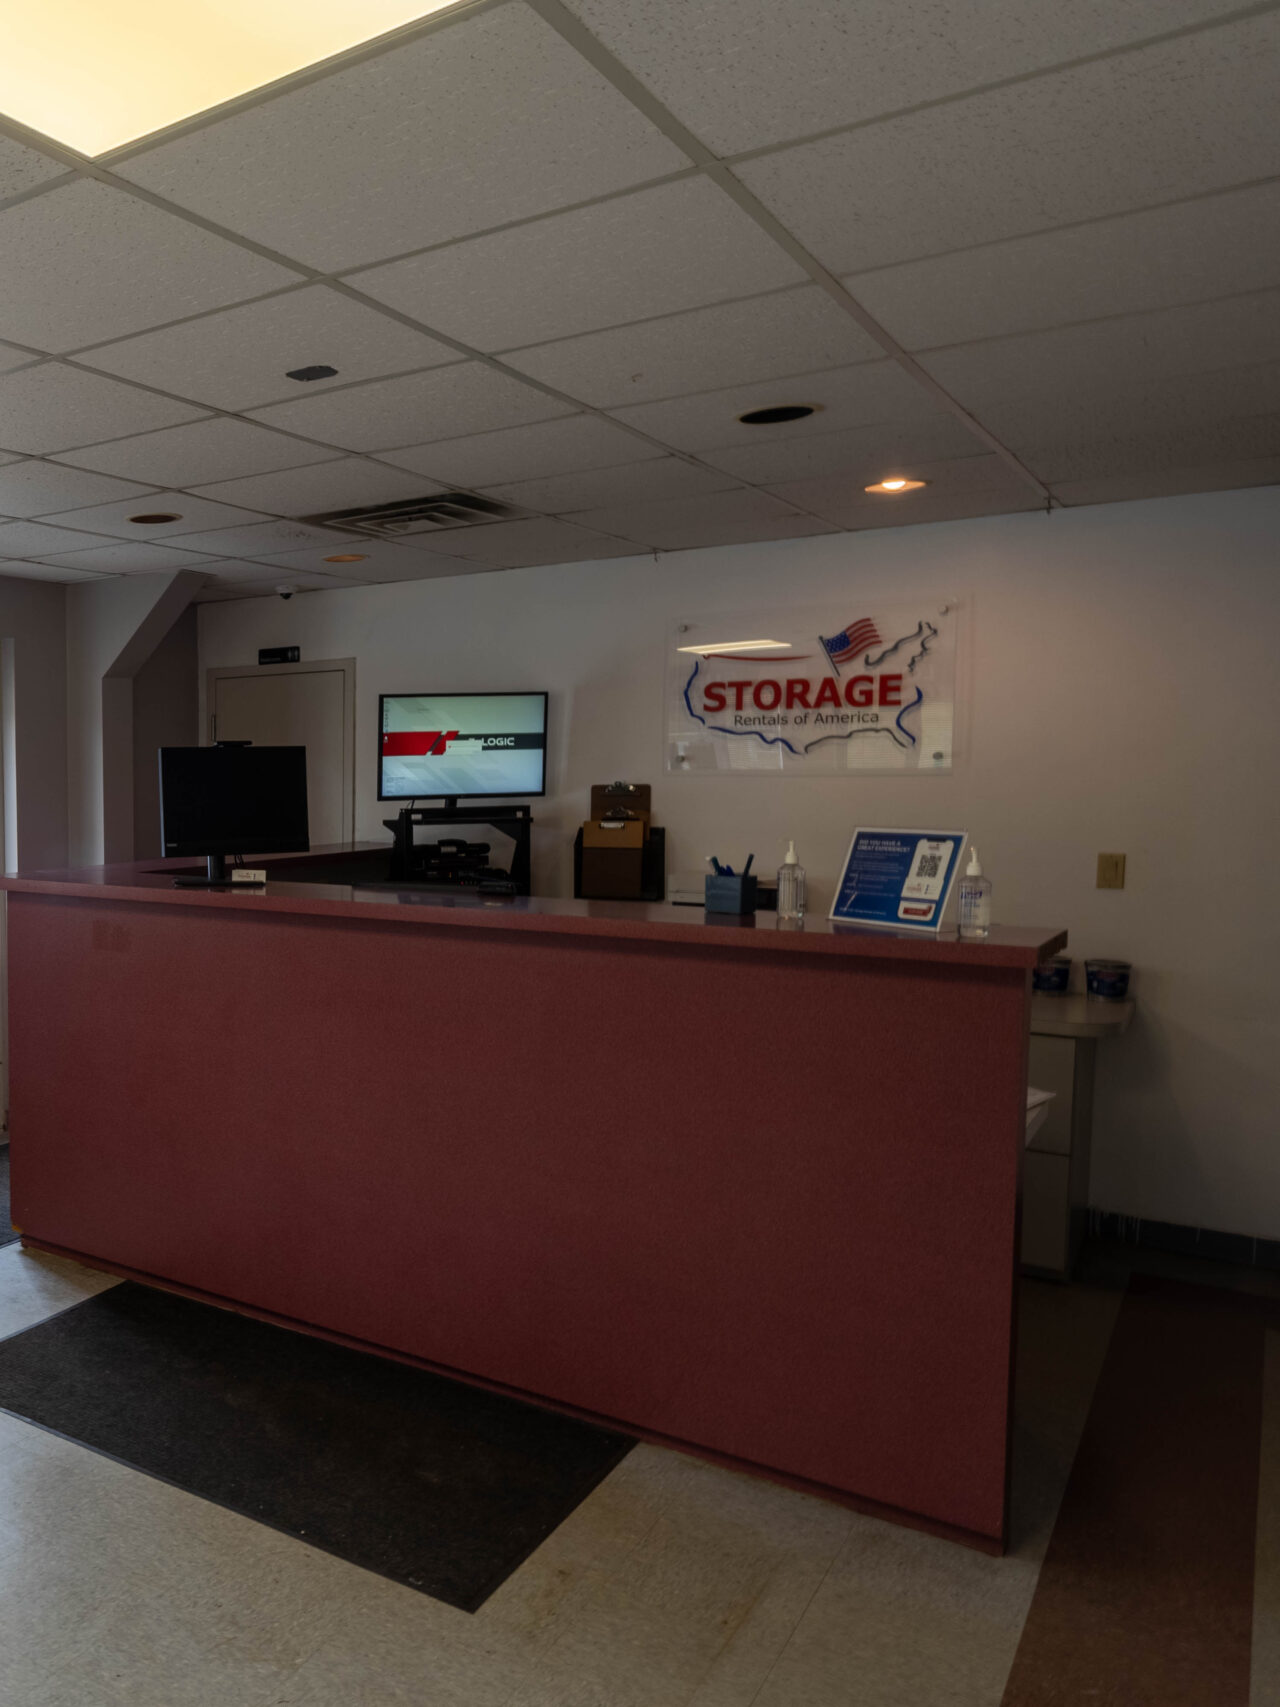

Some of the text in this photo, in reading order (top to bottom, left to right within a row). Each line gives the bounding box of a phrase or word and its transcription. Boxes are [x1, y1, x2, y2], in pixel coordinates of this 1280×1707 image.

[703, 673, 903, 712] STORAGE
[733, 710, 880, 727] Rentals of America
